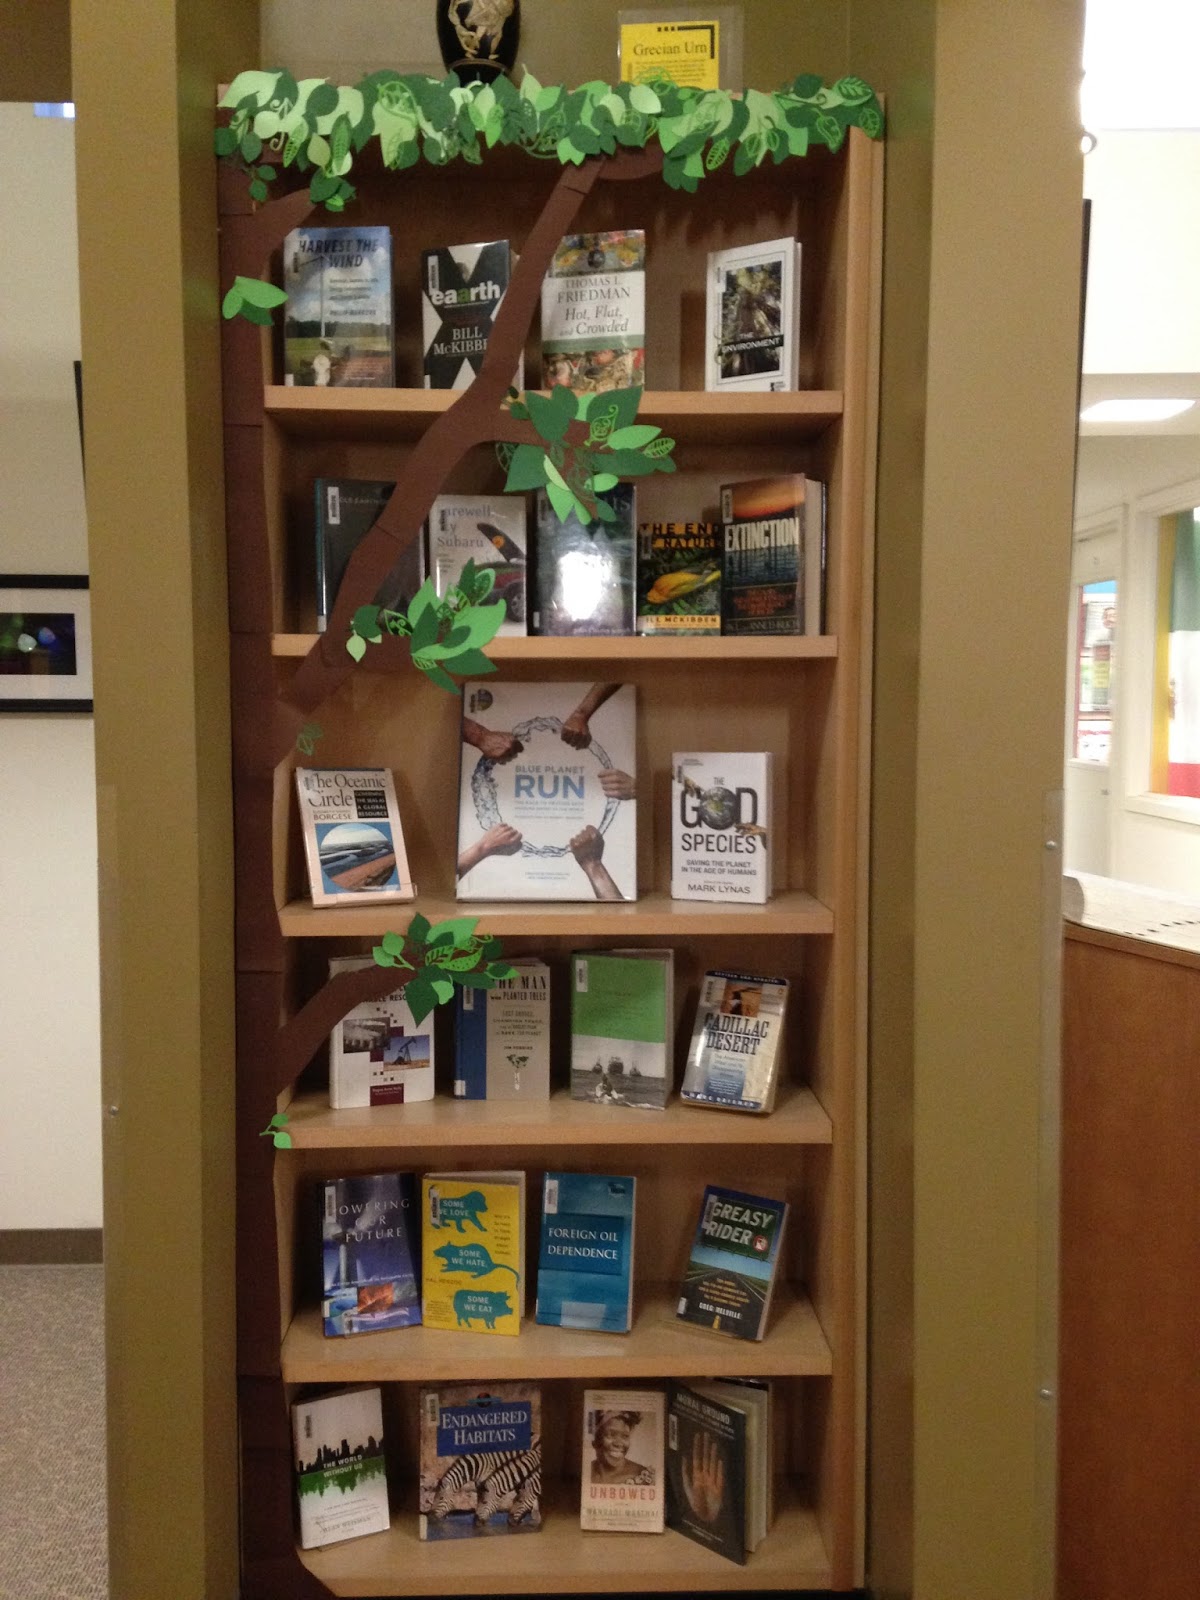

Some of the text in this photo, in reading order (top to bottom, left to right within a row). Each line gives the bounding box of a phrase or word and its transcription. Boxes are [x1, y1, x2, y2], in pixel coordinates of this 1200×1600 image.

[632, 41, 707, 56] Grecian Urn
[300, 239, 379, 253] HARVEST THE
[330, 254, 363, 268] WIND
[566, 278, 610, 288] THOMAS
[431, 280, 500, 305] eaarth
[558, 287, 630, 303] FRIEDMAN
[565, 307, 590, 321] Hot,
[452, 326, 482, 340] BILL
[576, 318, 629, 334] Crowded
[722, 337, 781, 351] ENVIRONMENT
[437, 534, 484, 547] Subaru
[725, 517, 799, 551] EXTINCTION
[544, 766, 584, 774] PLANET
[334, 773, 386, 788] Oceanic
[514, 774, 585, 799] RUN
[714, 777, 724, 785] THE
[680, 786, 758, 830] GOD
[682, 834, 756, 854] SPECIES
[728, 868, 756, 876] HUMANS
[688, 884, 750, 894] MARK LYNAS
[521, 976, 546, 989] MAN
[503, 992, 528, 1000] PLANTED
[704, 1012, 770, 1038] CADILLAC
[706, 1030, 760, 1055] DESERT
[442, 1200, 464, 1208] SOME
[711, 1202, 774, 1228] GREASY
[346, 1227, 402, 1243] FUTURE
[548, 1228, 618, 1242] FOREIGN OIL
[705, 1221, 752, 1245] RIDER
[458, 1250, 481, 1258] SOME
[548, 1245, 618, 1260] DEPENDENCE
[464, 1304, 492, 1313] WE EAT
[699, 1302, 714, 1312] GREG
[676, 1392, 699, 1410] MORAL
[702, 1404, 730, 1425] GROUND
[442, 1410, 528, 1429] ENDANGERED
[454, 1428, 516, 1446] HABITATS
[338, 1454, 362, 1466] WORLD
[323, 1467, 352, 1478] WITHOUT
[590, 1487, 656, 1500] UNBOWED
